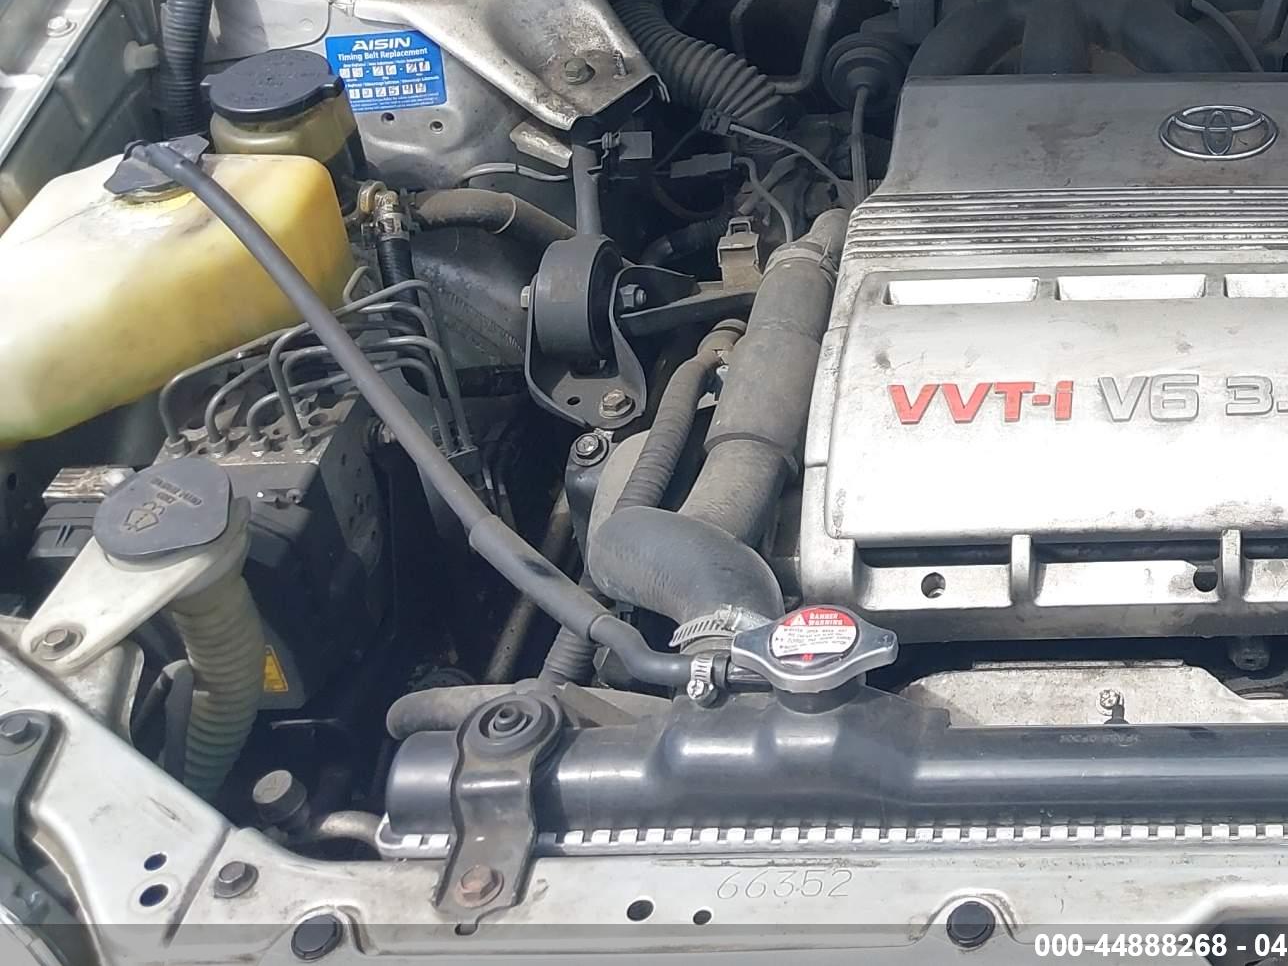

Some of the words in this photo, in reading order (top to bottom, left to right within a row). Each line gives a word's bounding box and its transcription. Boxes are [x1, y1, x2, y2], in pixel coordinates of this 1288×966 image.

[337, 53, 363, 62] Timing
[364, 51, 381, 60] Belt
[380, 47, 429, 59] Replacement
[352, 36, 411, 51] AISIN
[1098, 372, 1201, 423] V6
[716, 869, 853, 900] 66352
